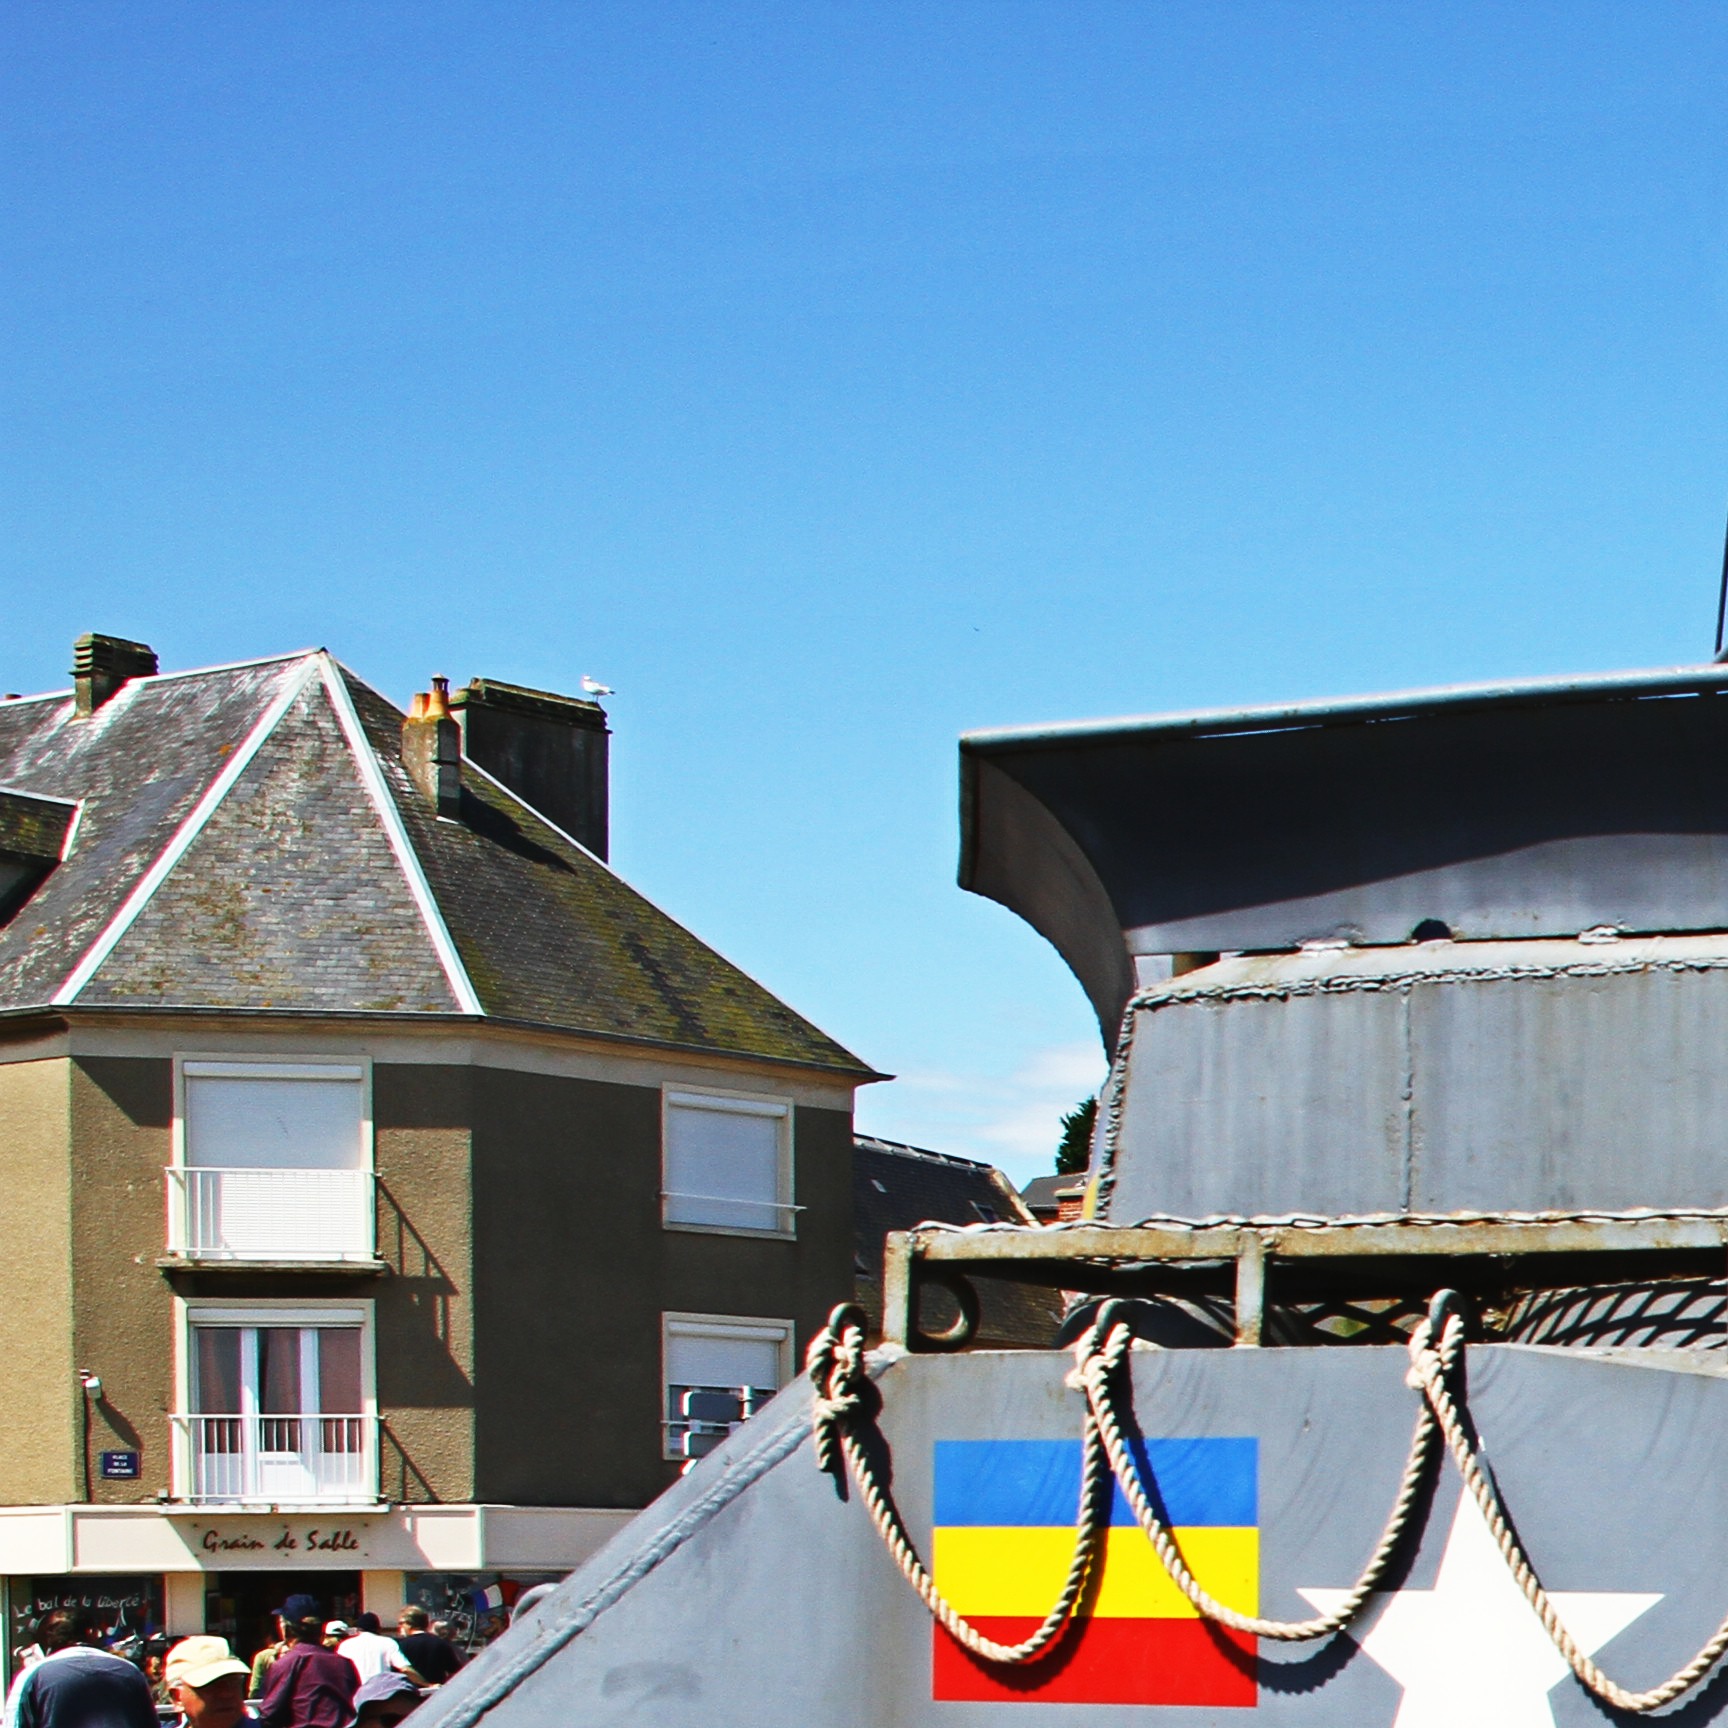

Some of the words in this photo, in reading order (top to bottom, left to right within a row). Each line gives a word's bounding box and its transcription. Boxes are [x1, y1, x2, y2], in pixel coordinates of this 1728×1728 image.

[203, 1530, 264, 1552] Grain
[274, 1531, 297, 1550] de
[307, 1529, 359, 1551] Sable
[38, 1595, 59, 1611] bal
[63, 1595, 78, 1608] de
